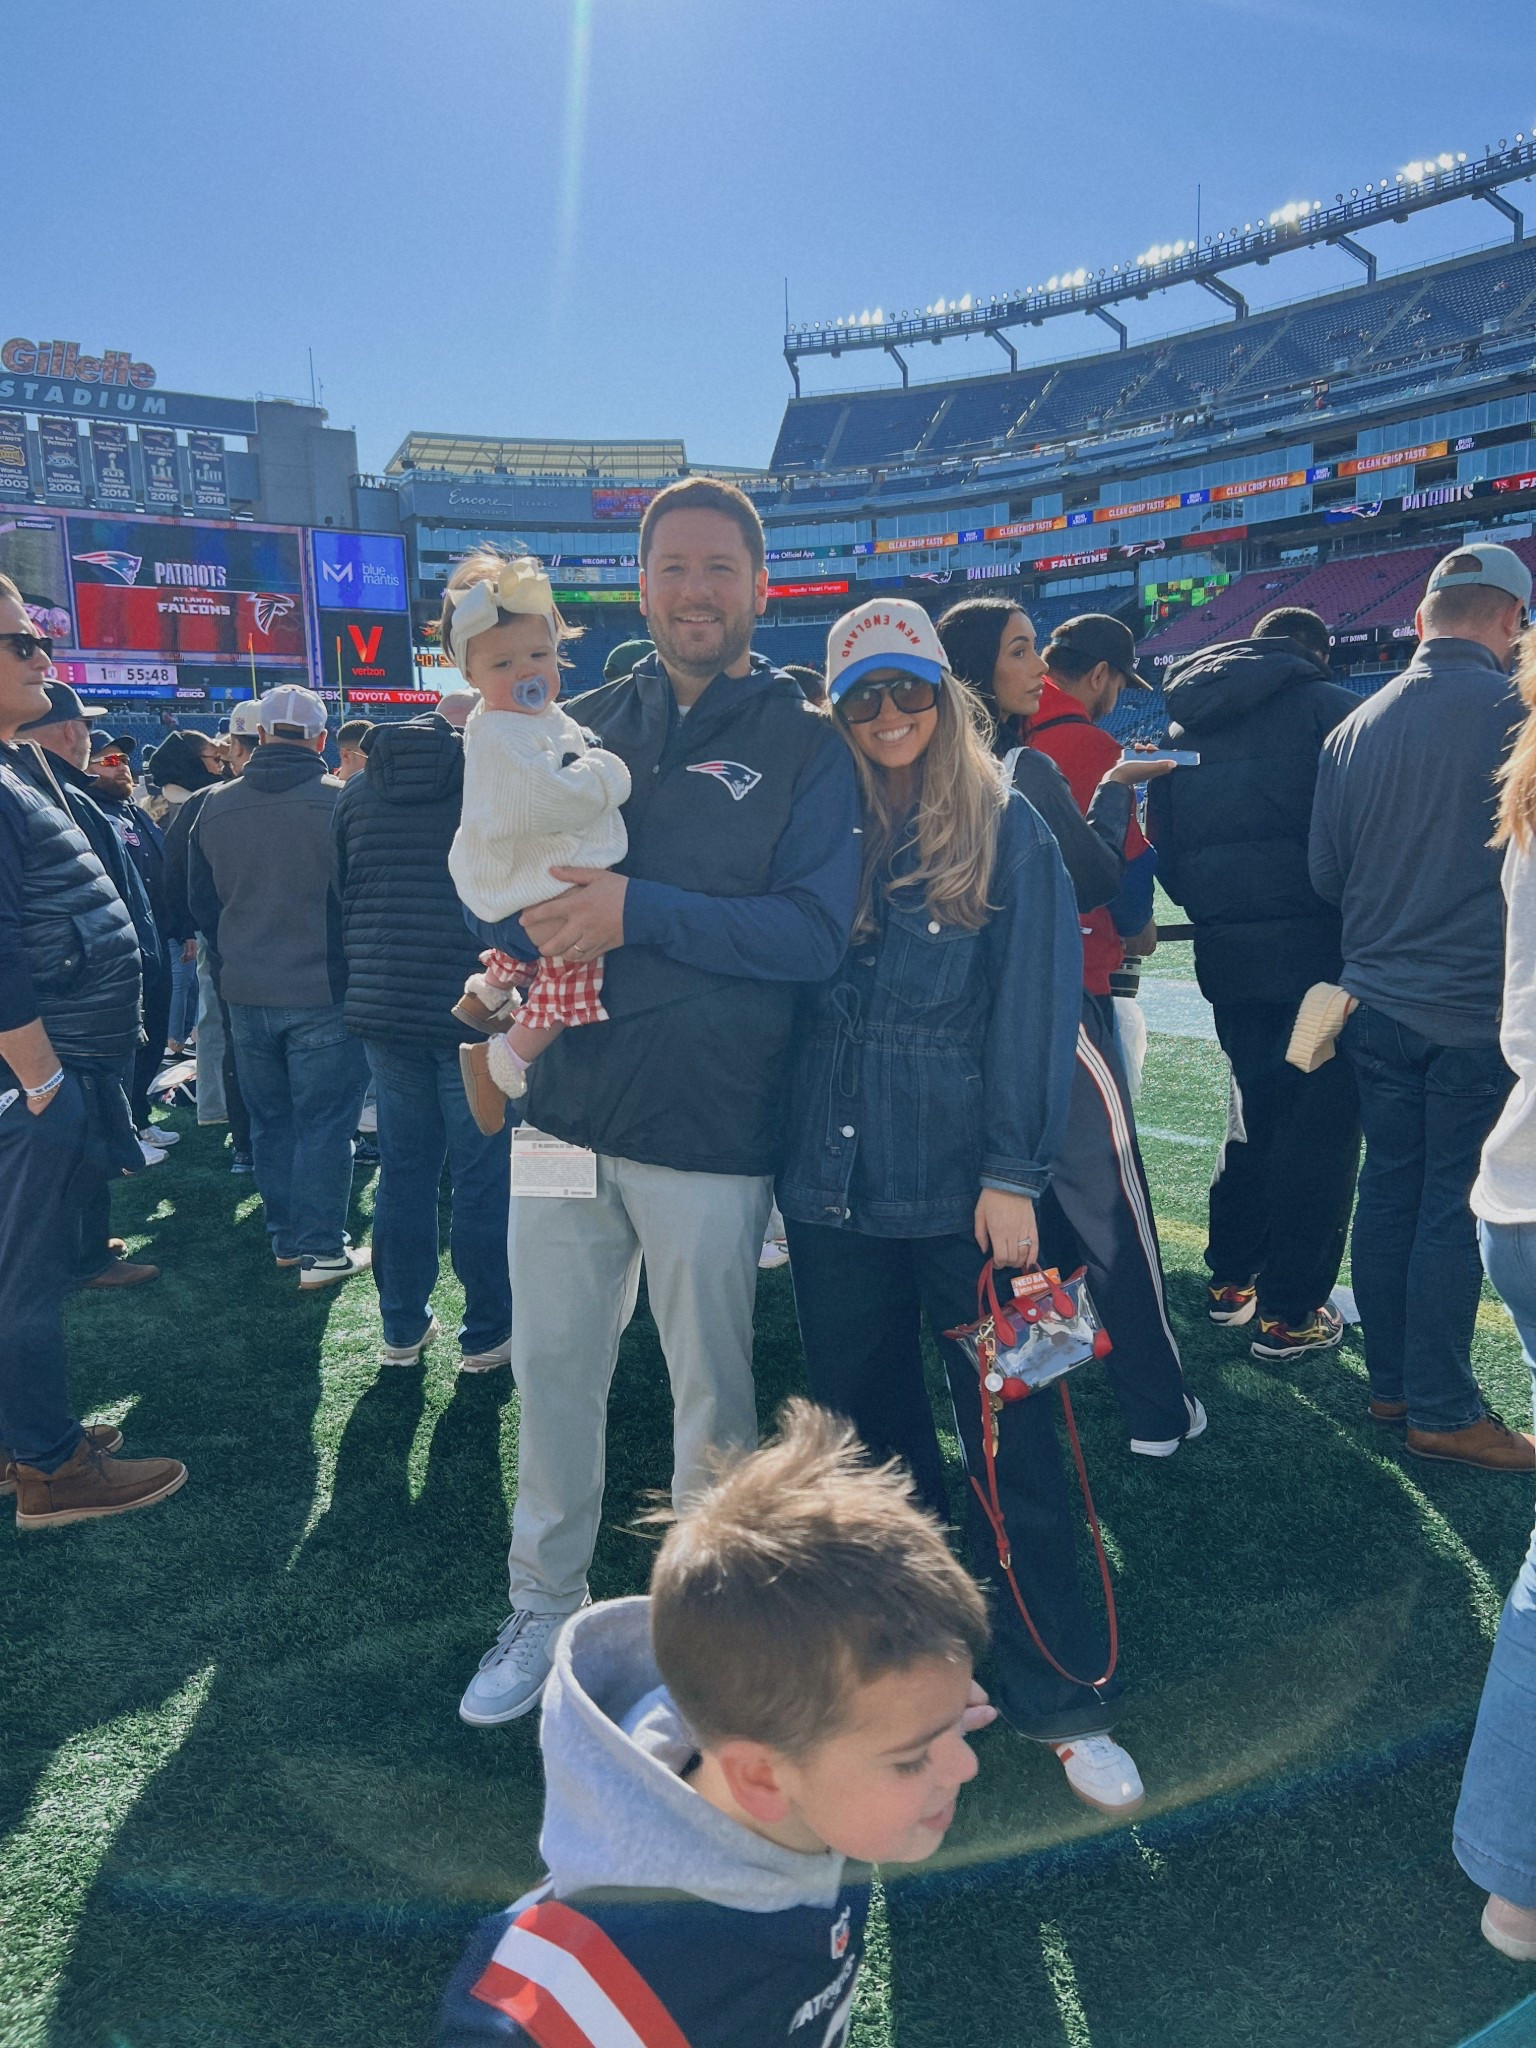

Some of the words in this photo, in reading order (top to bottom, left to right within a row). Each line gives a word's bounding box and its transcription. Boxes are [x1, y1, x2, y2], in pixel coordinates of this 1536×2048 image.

[1, 337, 157, 391] Gillette
[0, 379, 167, 415] STADIUM
[1357, 458, 1381, 471] CLEAN
[1382, 453, 1403, 467] CRISP
[1404, 447, 1427, 462] TASTE
[48, 483, 81, 494] 2004
[101, 488, 130, 499] 2014
[1226, 485, 1247, 496] CLEAN
[1248, 481, 1267, 492] CRISP
[1268, 477, 1288, 489] TASTE
[150, 492, 178, 502] 2016
[198, 495, 225, 505] 2018
[448, 488, 513, 507] Encore
[1109, 507, 1128, 517] CLEAN
[1128, 504, 1146, 514] CRISP
[1146, 500, 1165, 511] TASTE
[1000, 526, 1018, 536] CLEAN
[1018, 523, 1035, 534] CRISP
[1035, 520, 1053, 531] TASTE
[888, 540, 907, 550] CLEAN
[907, 538, 925, 548] CRISP
[925, 536, 944, 547] TASTE
[582, 557, 608, 565] WELCOME
[781, 550, 802, 559] Official
[802, 549, 815, 559] App
[1050, 552, 1108, 570] FALCONS
[154, 561, 227, 588] PATRIOTS
[362, 563, 386, 576] blue
[363, 573, 400, 587] mantis
[172, 596, 214, 604] ATLANTA
[156, 602, 231, 616] FALCONS
[841, 614, 890, 658] ENGLAND
[895, 620, 921, 645] NEW
[1349, 633, 1368, 643] DOWNS
[1153, 654, 1175, 667] 0:00
[101, 667, 117, 681] 1ST
[127, 667, 169, 682] 55:48
[351, 665, 386, 677] verizon
[77, 687, 88, 695] the
[97, 687, 112, 696] with
[112, 688, 129, 698] great
[350, 690, 391, 702] TOYOTA
[398, 692, 438, 702] TOYOTA
